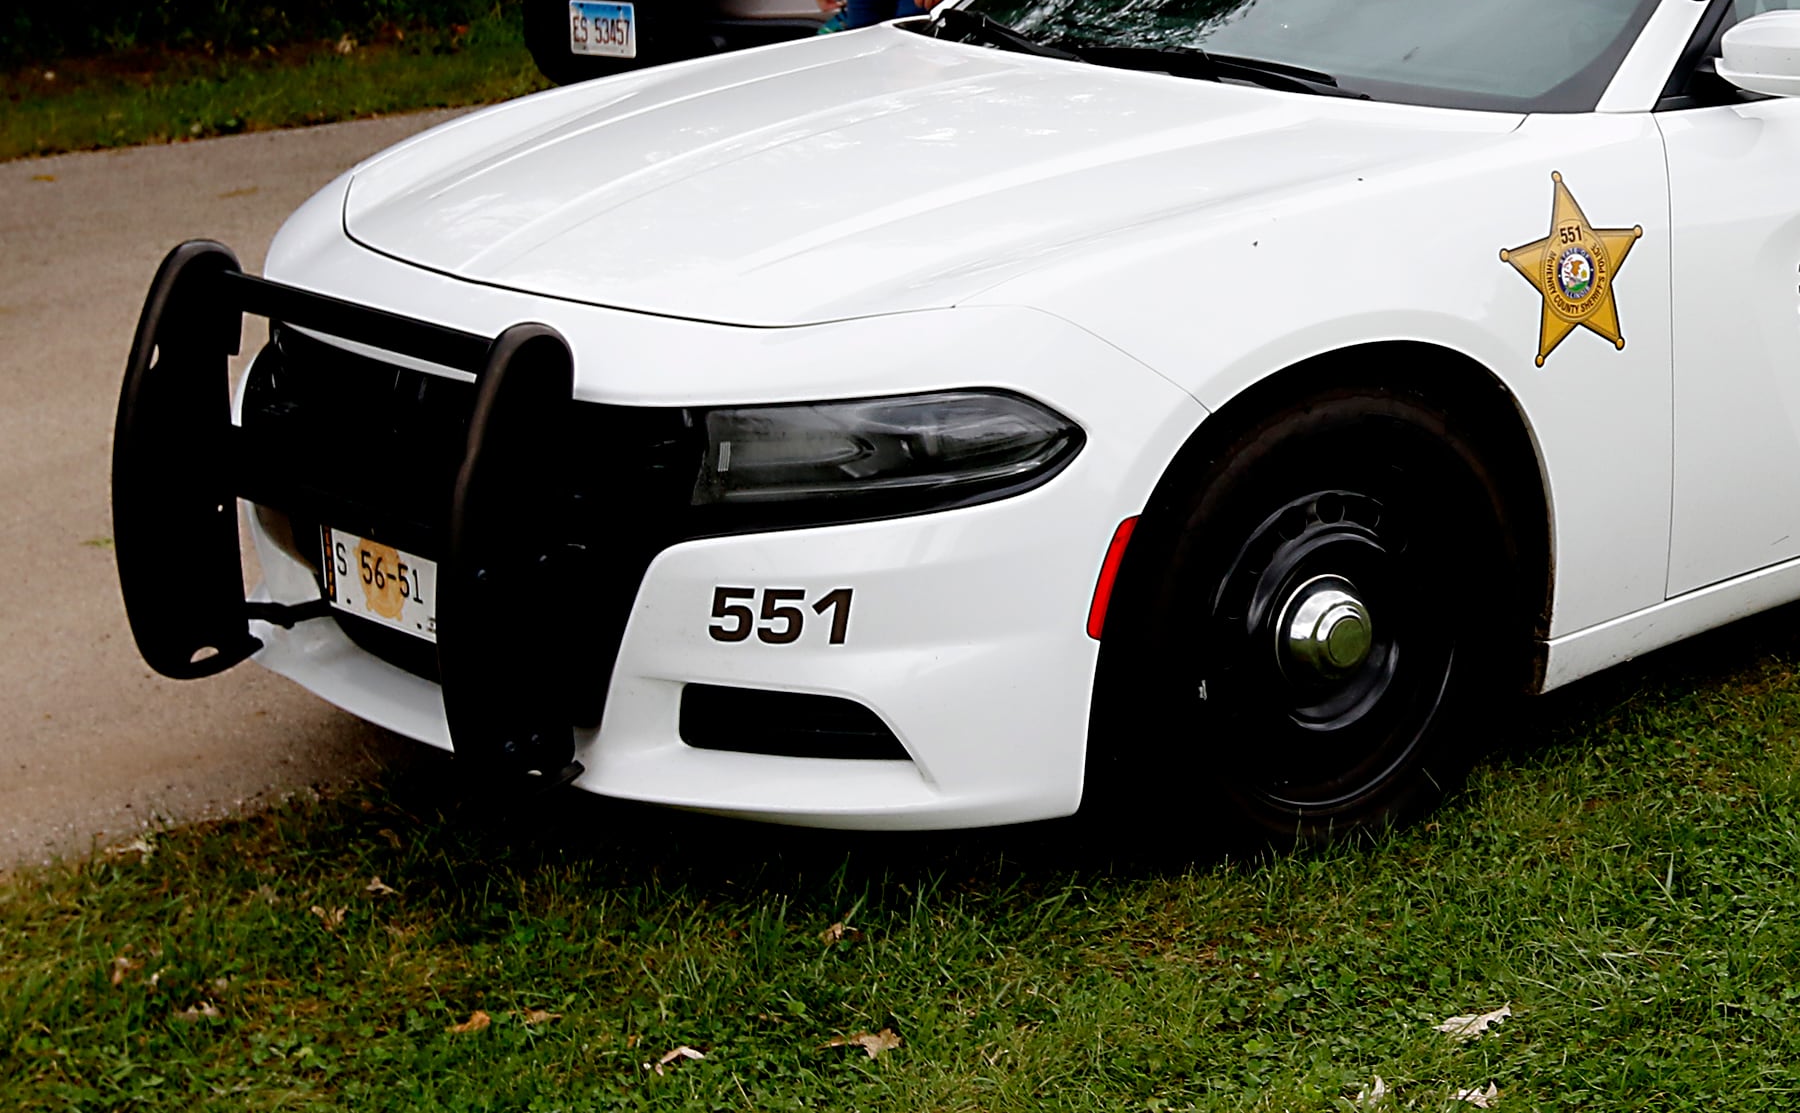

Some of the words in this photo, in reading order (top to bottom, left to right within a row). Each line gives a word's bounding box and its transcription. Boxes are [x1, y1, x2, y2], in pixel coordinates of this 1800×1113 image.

[573, 15, 588, 43] ES
[594, 16, 630, 46] 53457
[1560, 225, 1582, 244] 551
[1553, 293, 1579, 314] COUNTY
[335, 541, 348, 576] S
[360, 549, 424, 605] 56-51
[708, 586, 854, 645] 551
